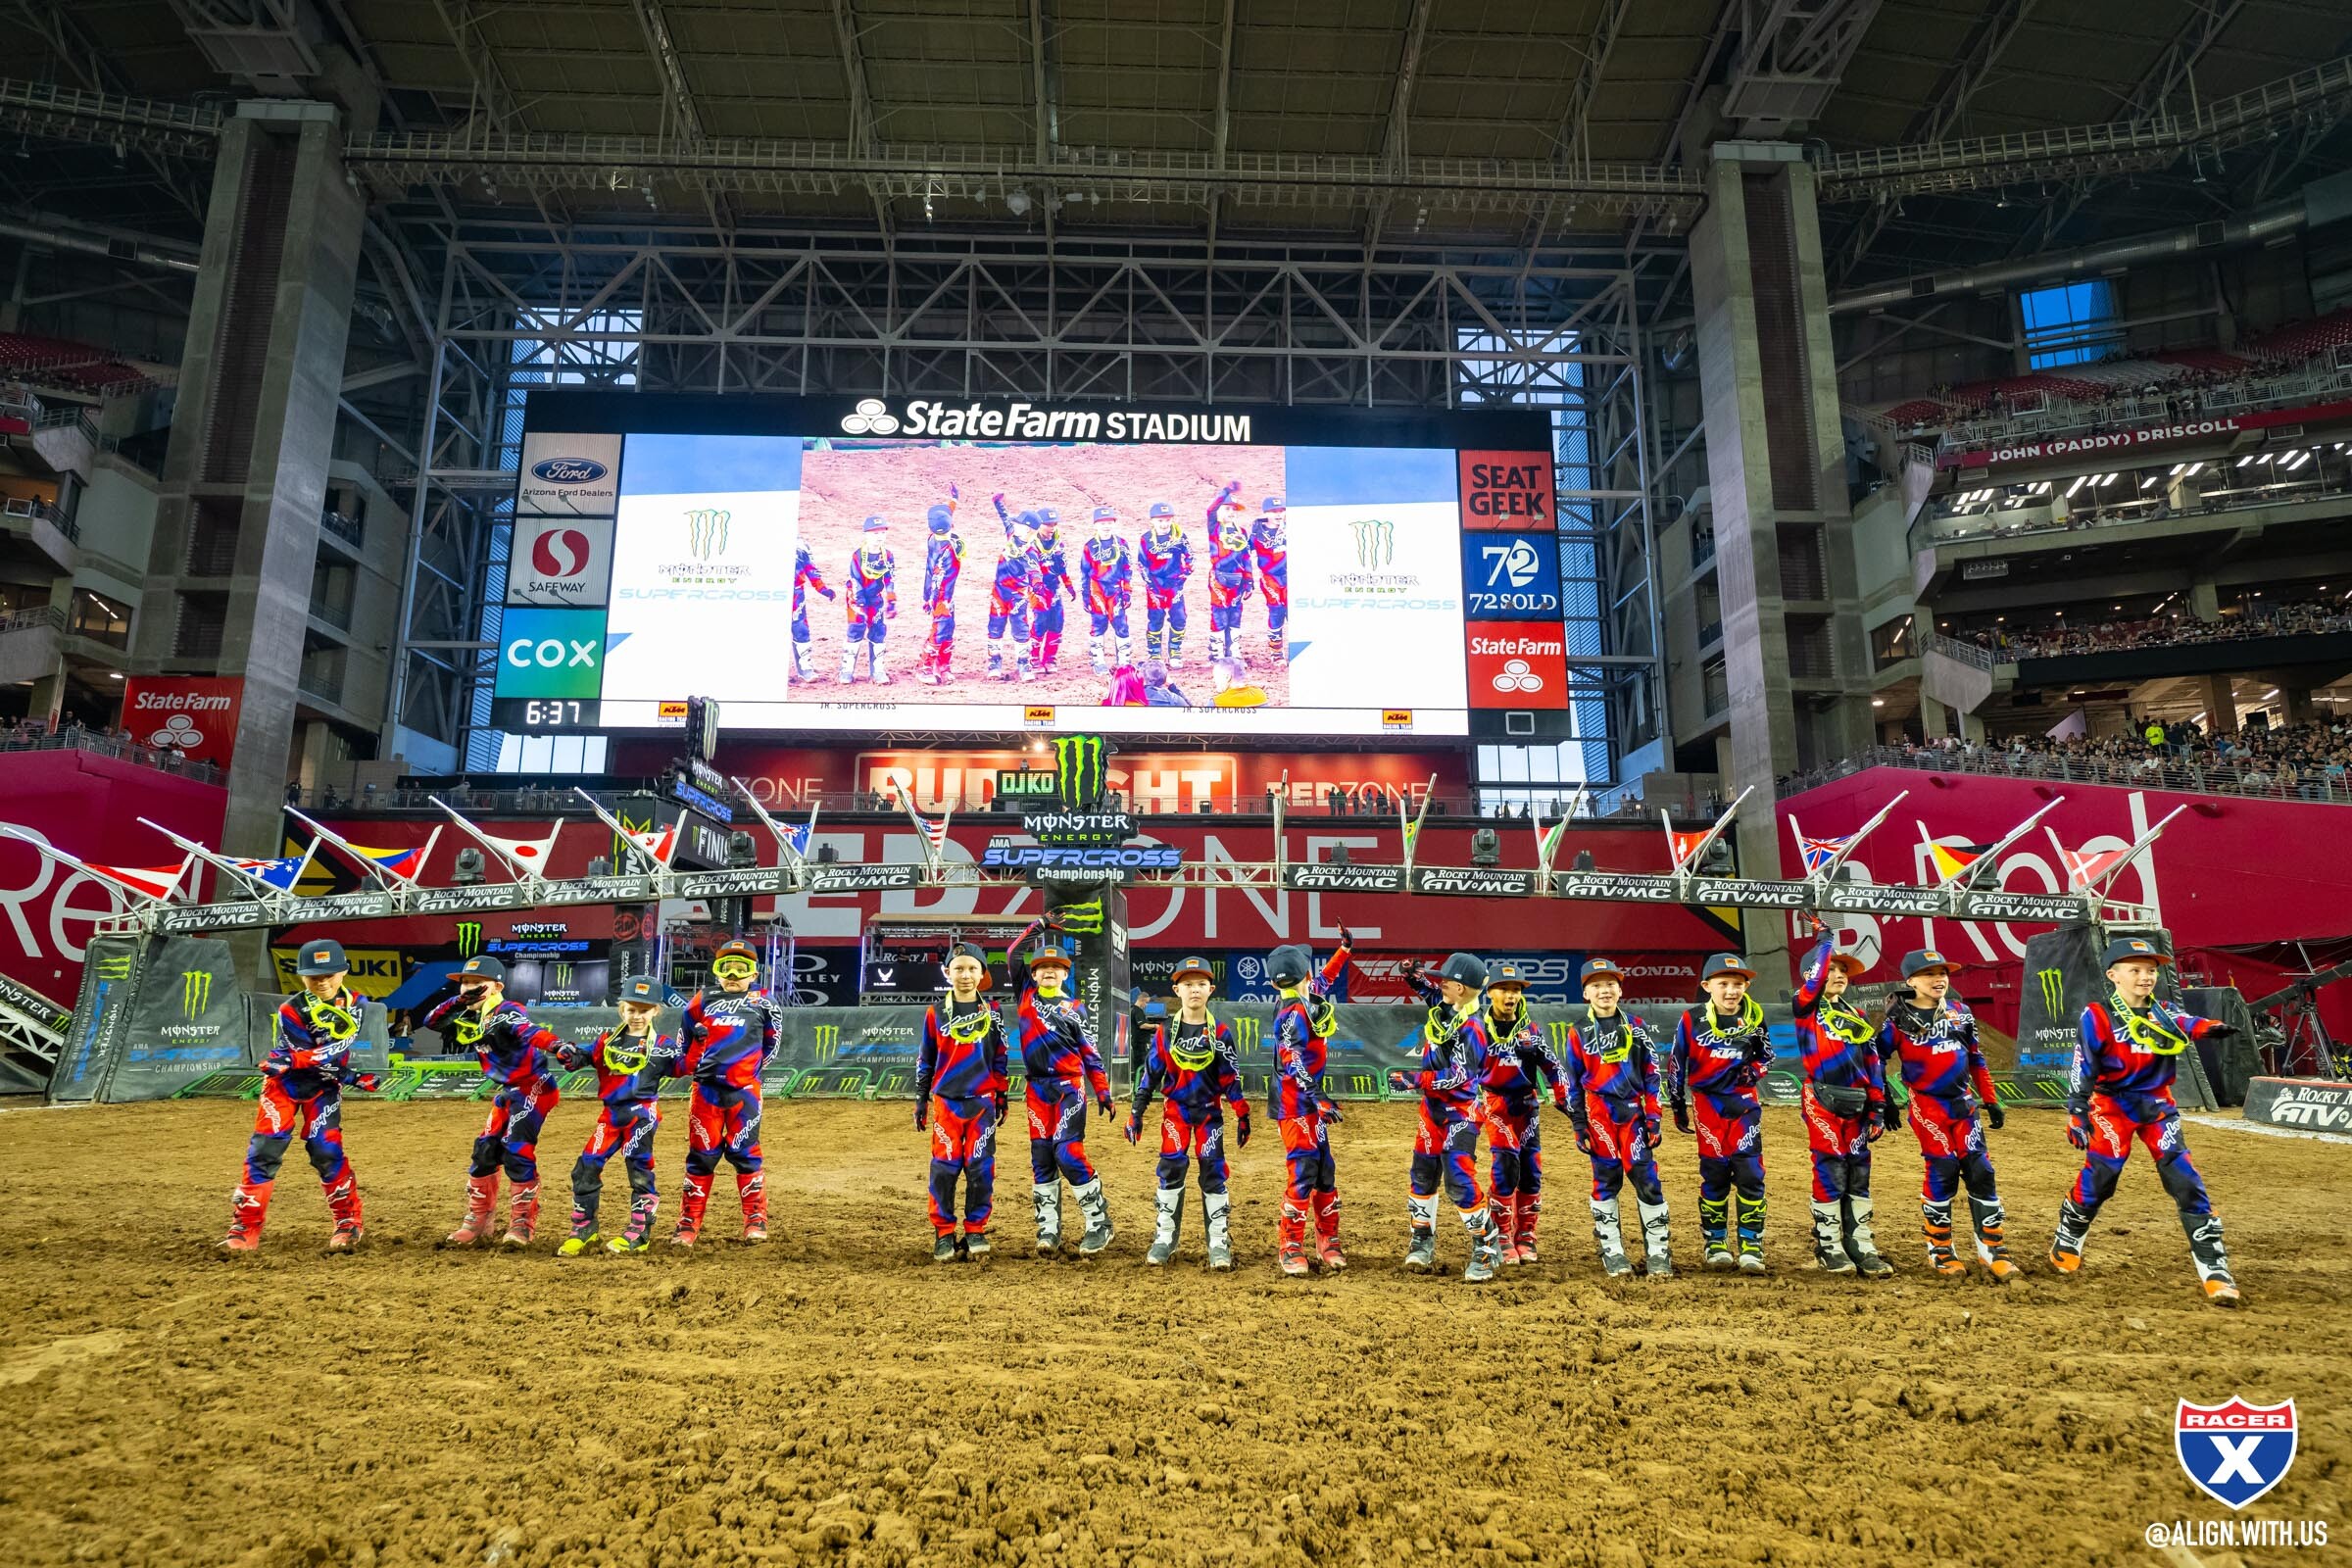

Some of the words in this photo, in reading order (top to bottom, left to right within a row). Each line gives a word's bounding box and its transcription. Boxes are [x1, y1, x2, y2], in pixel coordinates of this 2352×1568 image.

[1106, 414, 1250, 442] STADIUM
[1989, 446, 2040, 463] JOHN
[2046, 433, 2131, 456] (PADDY)
[2136, 418, 2239, 443] DRISCOLL
[546, 461, 590, 481] Ford
[1472, 464, 1543, 489] SEAT
[559, 488, 578, 497] Ford
[579, 489, 613, 498] Dealers
[1469, 492, 1546, 516] GEEK
[659, 563, 753, 576] MONSTER
[1482, 539, 1539, 588] 72
[1330, 573, 1420, 586] MONSTER
[529, 581, 586, 593] SAFEWAY
[618, 588, 787, 602] SUPERCROSS
[1295, 598, 1457, 611] SUPERCROSS
[507, 639, 597, 667] COX
[526, 701, 580, 724] 6:37
[692, 760, 723, 790] MONSTER
[676, 780, 733, 823] SUPERCROSS
[1024, 812, 1130, 831] MONSTER
[989, 839, 1010, 848] AMA
[982, 849, 1183, 866] SUPERCROSS
[698, 873, 728, 884] ROCKY
[729, 870, 780, 881] MOUNTAIN
[827, 867, 858, 877] ROCKY
[858, 866, 911, 877] MOUNTAIN
[1037, 867, 1125, 882] Championship
[1311, 865, 1343, 875] ROCKY
[1345, 866, 1398, 877] MOUNTAIN
[1438, 869, 1468, 880] ROCKY
[1470, 870, 1527, 882] MOUNTAIN
[560, 880, 591, 891] ROCKY
[592, 878, 642, 890] MOUNTAIN
[1583, 874, 1613, 885] ROCKY
[1615, 876, 1672, 888] MOUNTAIN
[1714, 881, 1746, 892] ROCKY
[1747, 882, 1804, 894] MOUNTAIN
[434, 889, 465, 900] ROCKY
[466, 886, 514, 898] MOUNTAIN
[1847, 887, 1879, 899] ROCKY
[1881, 889, 1939, 901] MOUNTAIN
[1985, 893, 2020, 906] ROCKY
[2022, 896, 2079, 907] MOUNTAIN
[302, 898, 332, 907] ROCKY
[333, 895, 385, 906] MOUNTAIN
[179, 907, 209, 919] ROCKY
[211, 903, 260, 918] MOUNTAIN
[512, 922, 567, 934] MONSTER
[486, 942, 589, 953] SUPERCROSS
[279, 957, 398, 977] SUKI
[1619, 965, 1696, 977] HONDA
[2112, 992, 2135, 1022] 100%
[711, 1016, 746, 1027] KTM
[161, 1024, 220, 1037] MONSTER
[862, 1026, 914, 1037] MONSTER
[2034, 1027, 2078, 1041] MONSTE
[1710, 1048, 1743, 1059] KTM
[1932, 1040, 1962, 1055] KTM
[155, 1061, 221, 1074] CHAMPIONSHIP
[2295, 1087, 2343, 1104] ROCKY
